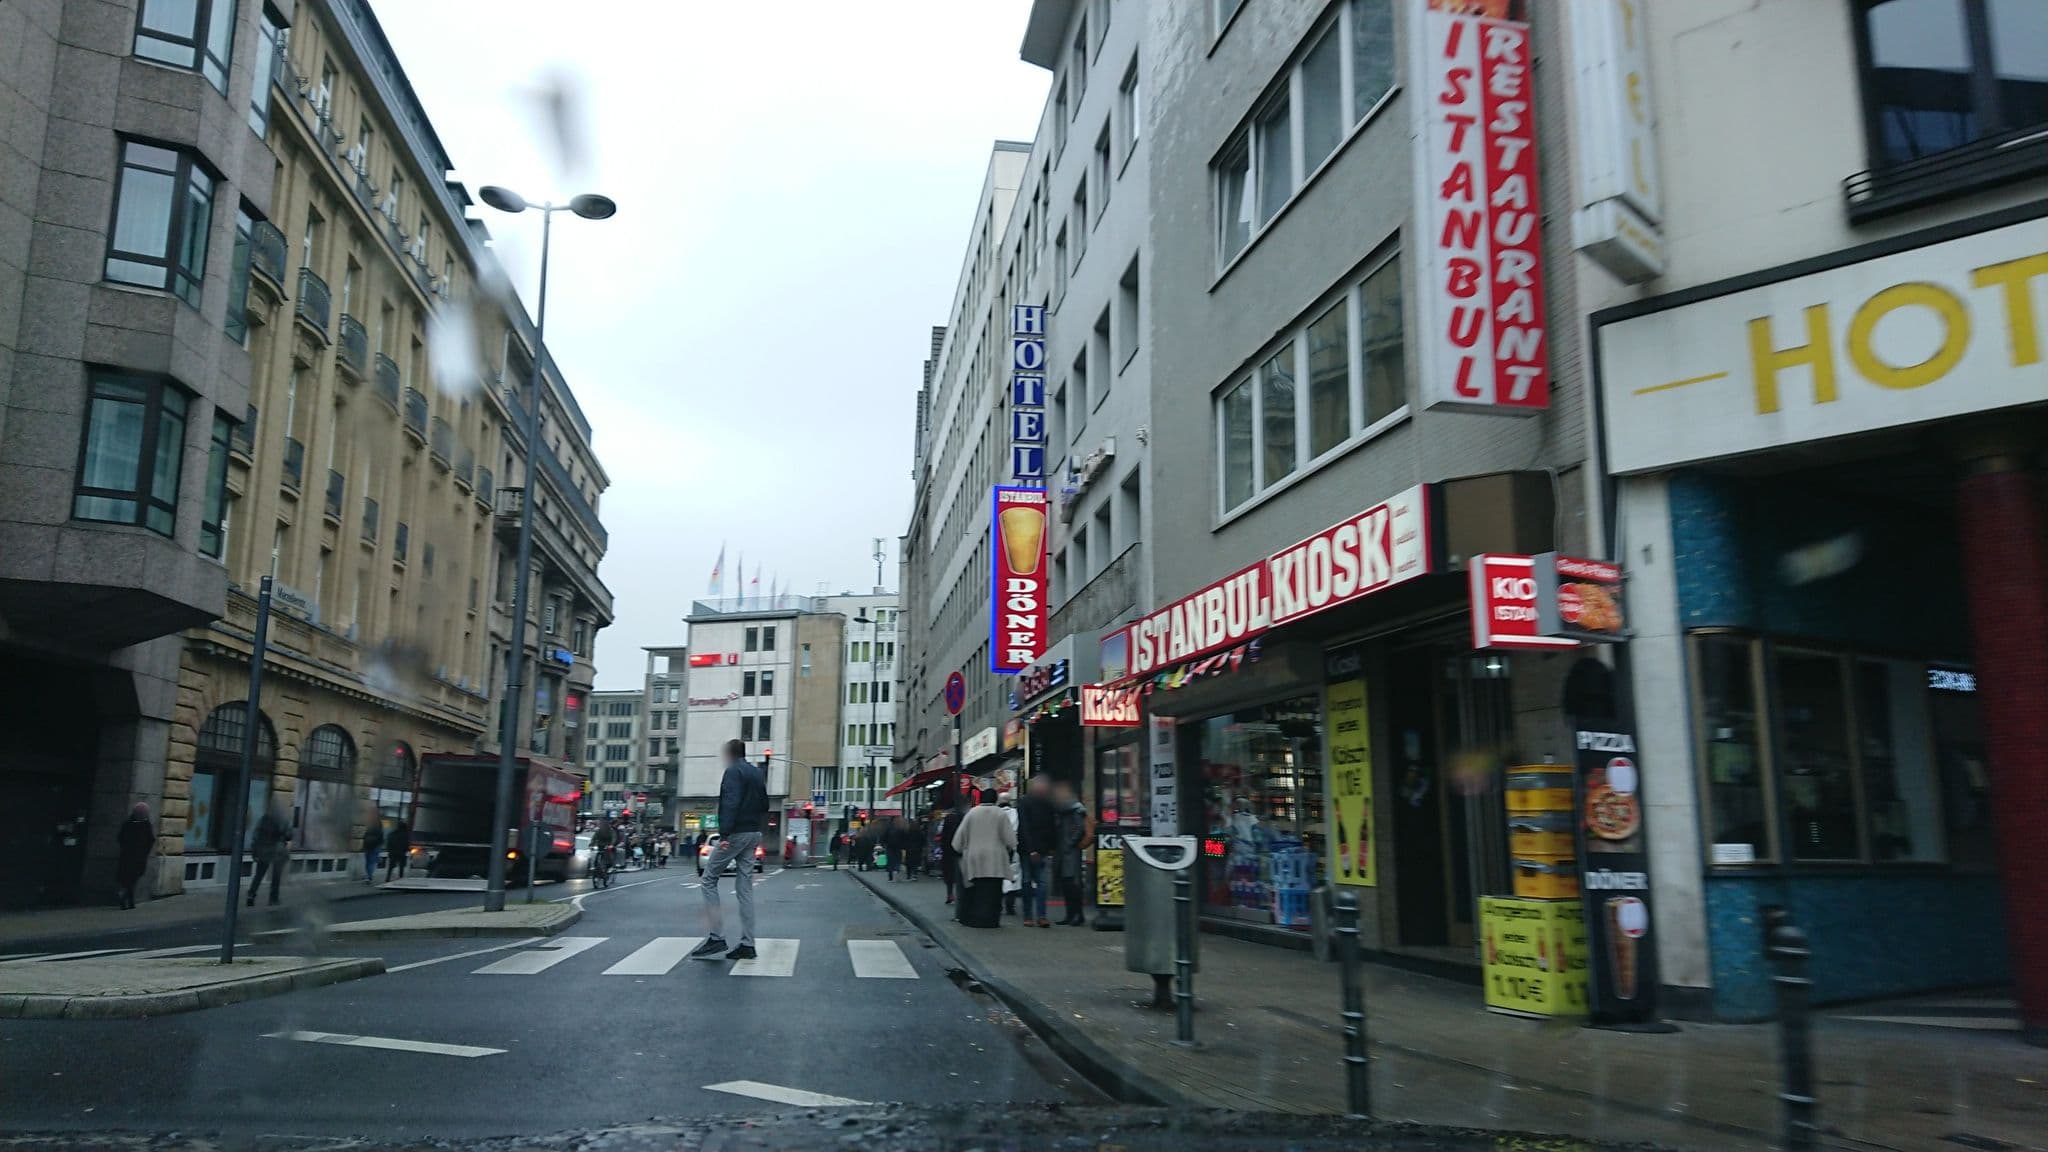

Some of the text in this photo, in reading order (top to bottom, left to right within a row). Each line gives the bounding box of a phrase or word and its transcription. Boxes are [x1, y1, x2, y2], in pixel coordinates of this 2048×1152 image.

[1440, 20, 1485, 397] ISTANBUL
[1486, 26, 1542, 400] RESTAURANT
[1017, 305, 1044, 478] HOTEL
[1006, 578, 1039, 663] DÖNER
[1131, 507, 1391, 674] ISTANBUL KIOSK
[1576, 730, 1637, 753] PIZZA
[1584, 867, 1649, 890] DÖNER
